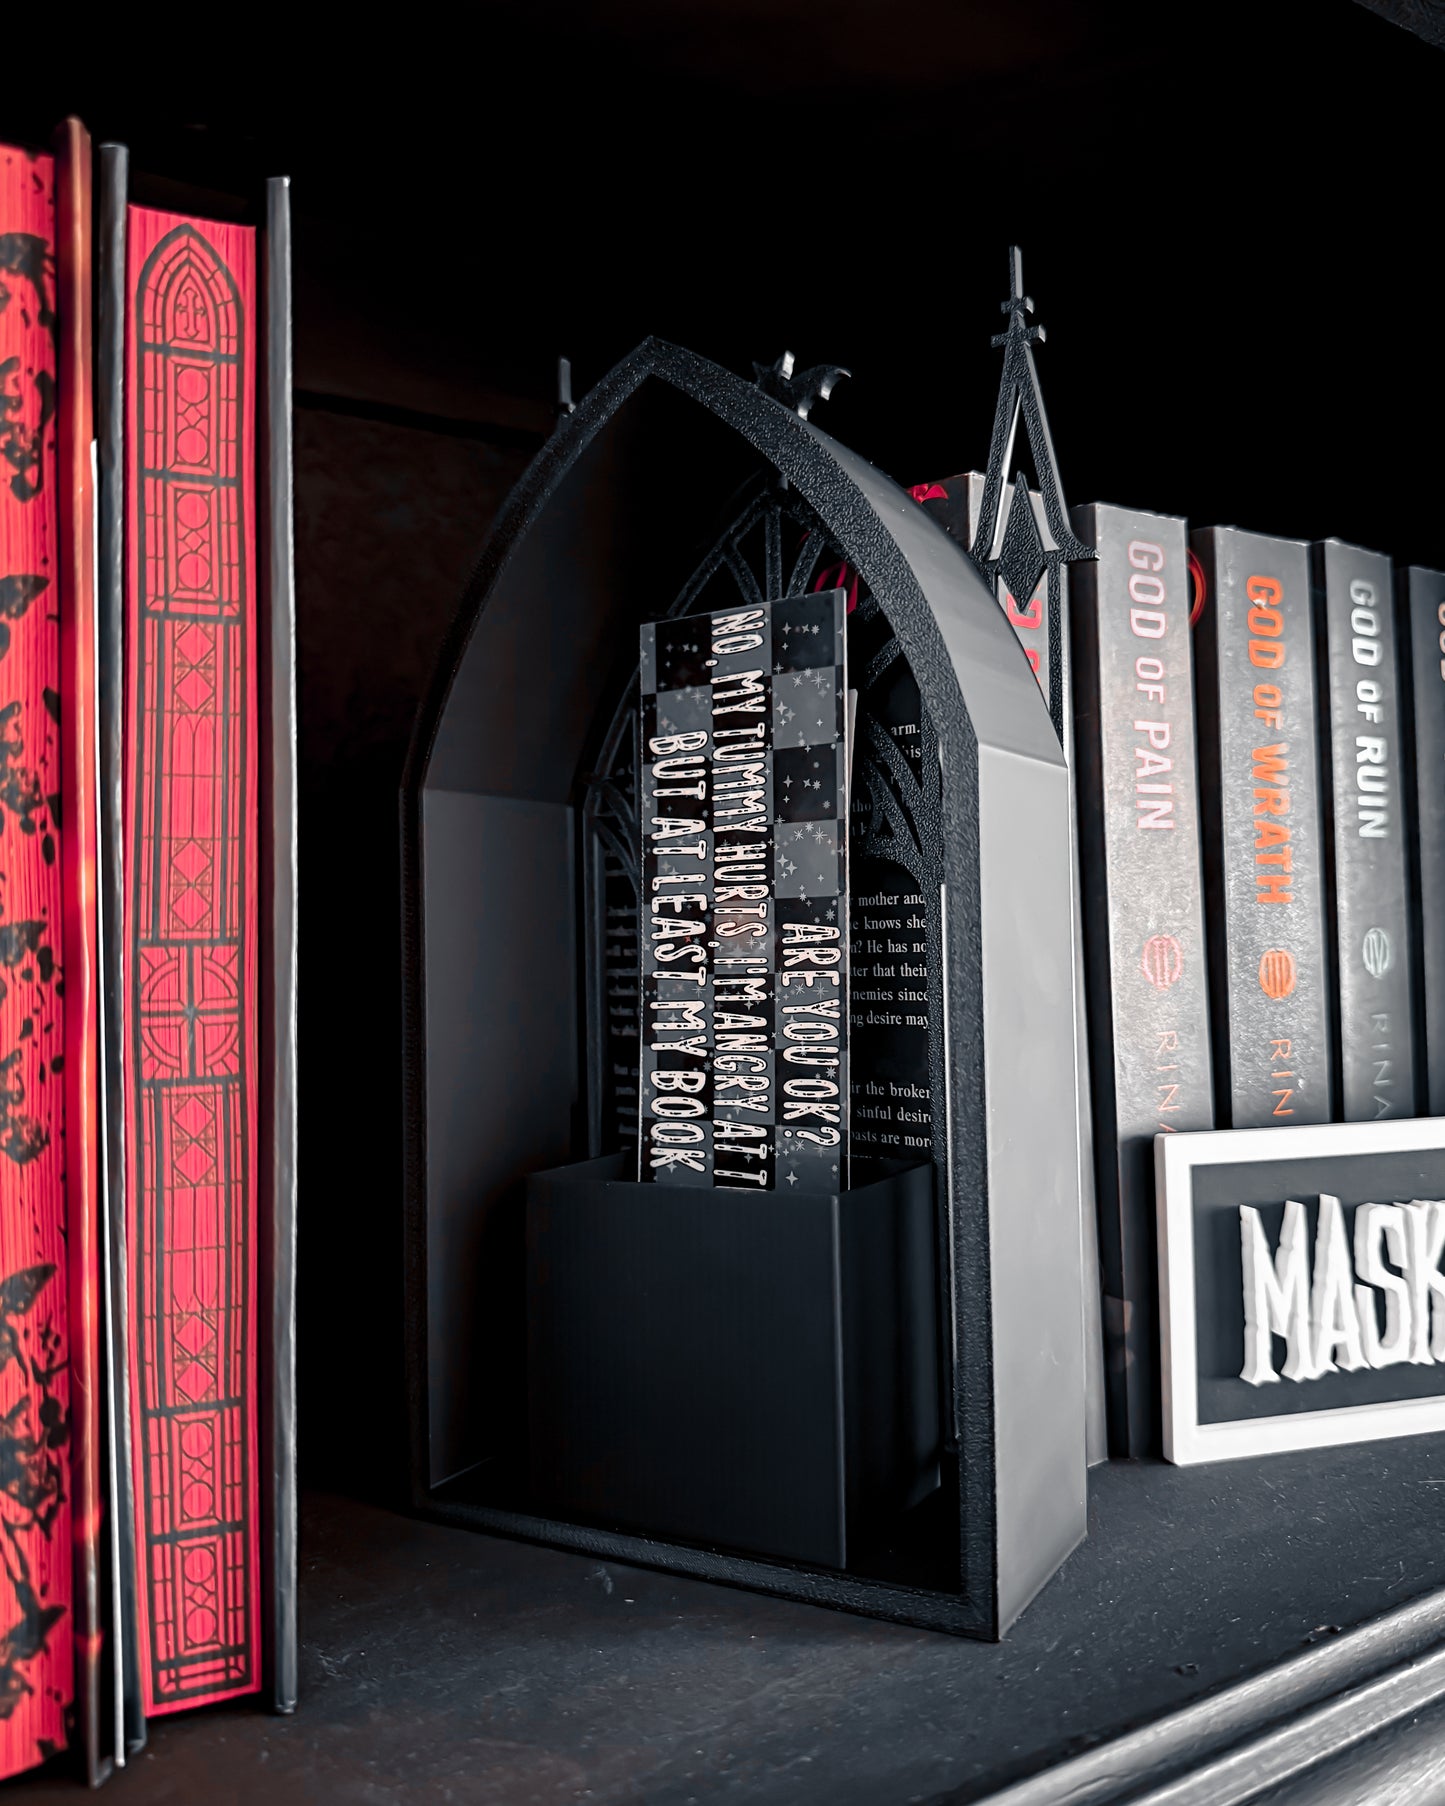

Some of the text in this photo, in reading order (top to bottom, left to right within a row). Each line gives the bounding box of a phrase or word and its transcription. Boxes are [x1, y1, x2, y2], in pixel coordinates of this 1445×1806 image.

[709, 669, 767, 716] MY
[1128, 540, 1175, 830] GOD OF PAIN
[1350, 579, 1389, 838] GOD OF RUIN
[1246, 575, 1293, 904] GOD OF WRATH
[710, 721, 769, 834] TUMMY
[858, 891, 900, 906] mother
[864, 915, 902, 930] knows
[649, 730, 709, 1173] BUT AT LEAST MY BOOK
[867, 939, 883, 954] He
[887, 938, 909, 953] has
[711, 956, 769, 1002] I'M
[872, 962, 896, 977] that
[851, 987, 894, 1001] nemies
[866, 1009, 902, 1025] desire
[781, 922, 842, 1147] ARE YOU OK?
[712, 1011, 770, 1113] ANGRY
[1270, 1038, 1295, 1117] RIN
[866, 1080, 885, 1096] the
[856, 1104, 892, 1120] sinful
[880, 1132, 900, 1145] are
